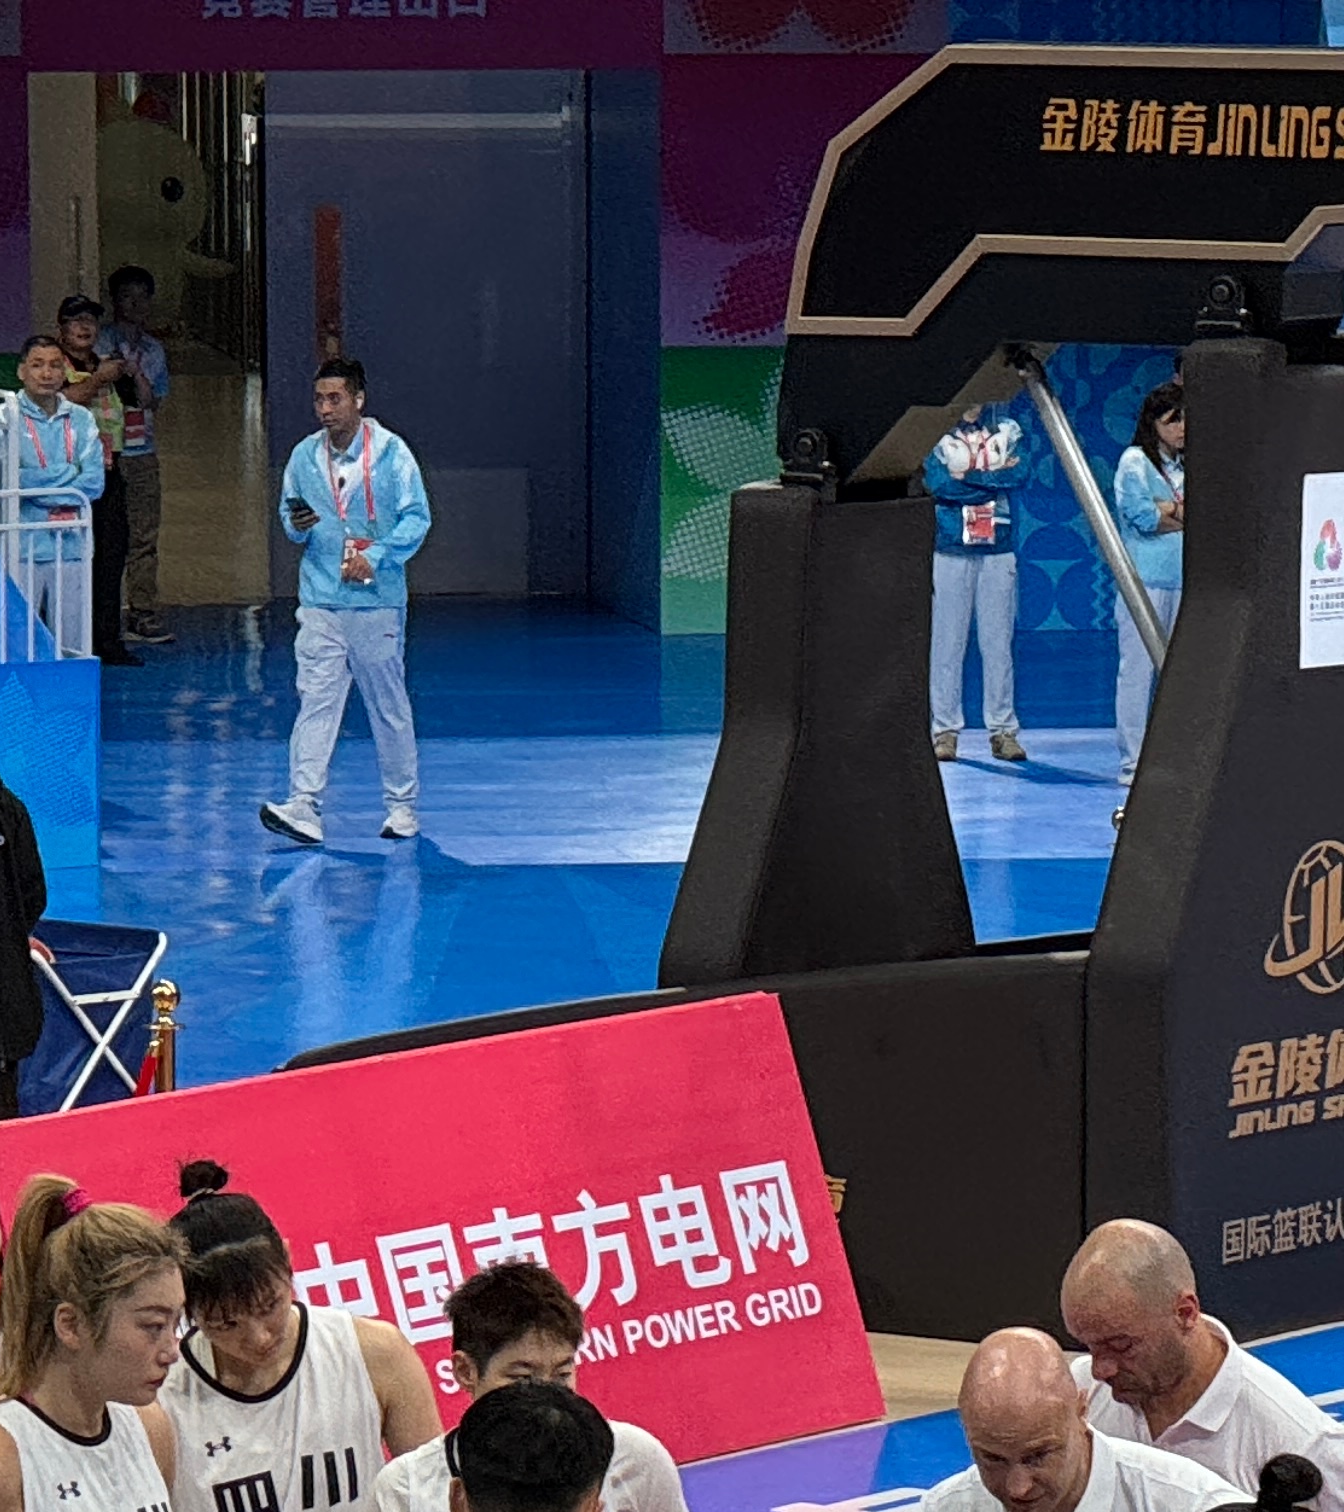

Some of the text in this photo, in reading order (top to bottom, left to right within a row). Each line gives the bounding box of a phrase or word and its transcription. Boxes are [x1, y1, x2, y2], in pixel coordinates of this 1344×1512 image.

[1040, 97, 1208, 153] 金陵体育
[1227, 1099, 1316, 1139] JINLING
[623, 1280, 824, 1358] POWER GRID
